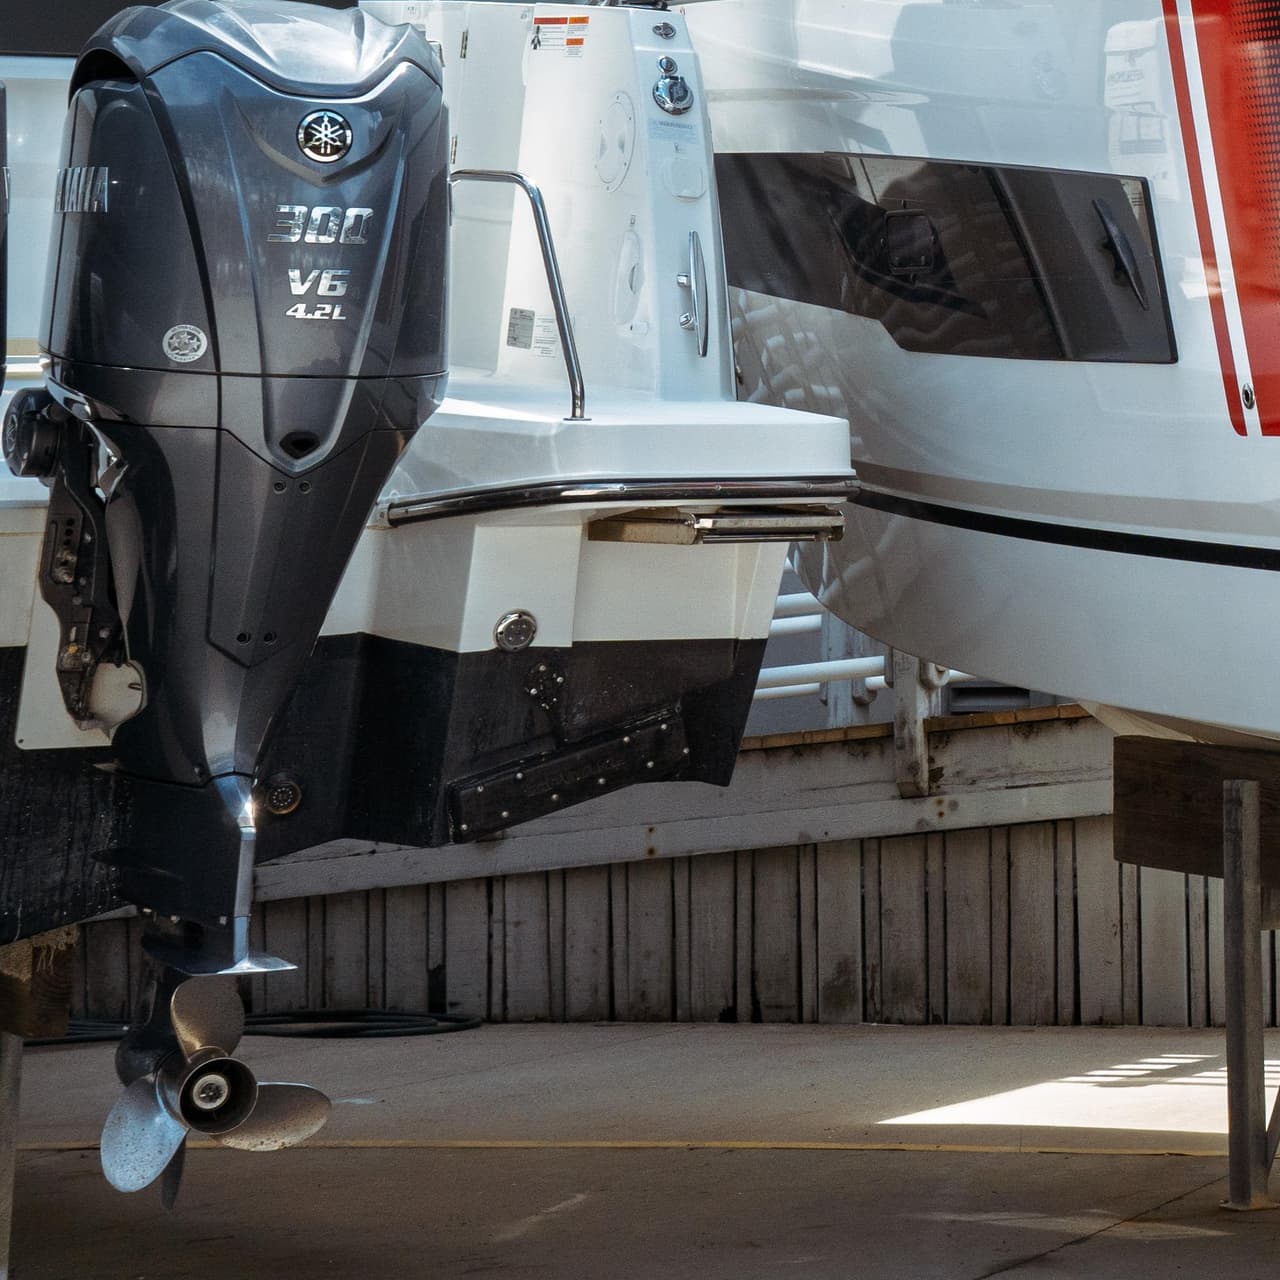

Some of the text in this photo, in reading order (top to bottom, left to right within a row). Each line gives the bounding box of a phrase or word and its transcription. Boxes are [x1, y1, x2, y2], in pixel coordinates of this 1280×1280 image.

[267, 204, 374, 245] 300
[288, 268, 352, 297] V6
[286, 303, 347, 320] 4.2L
